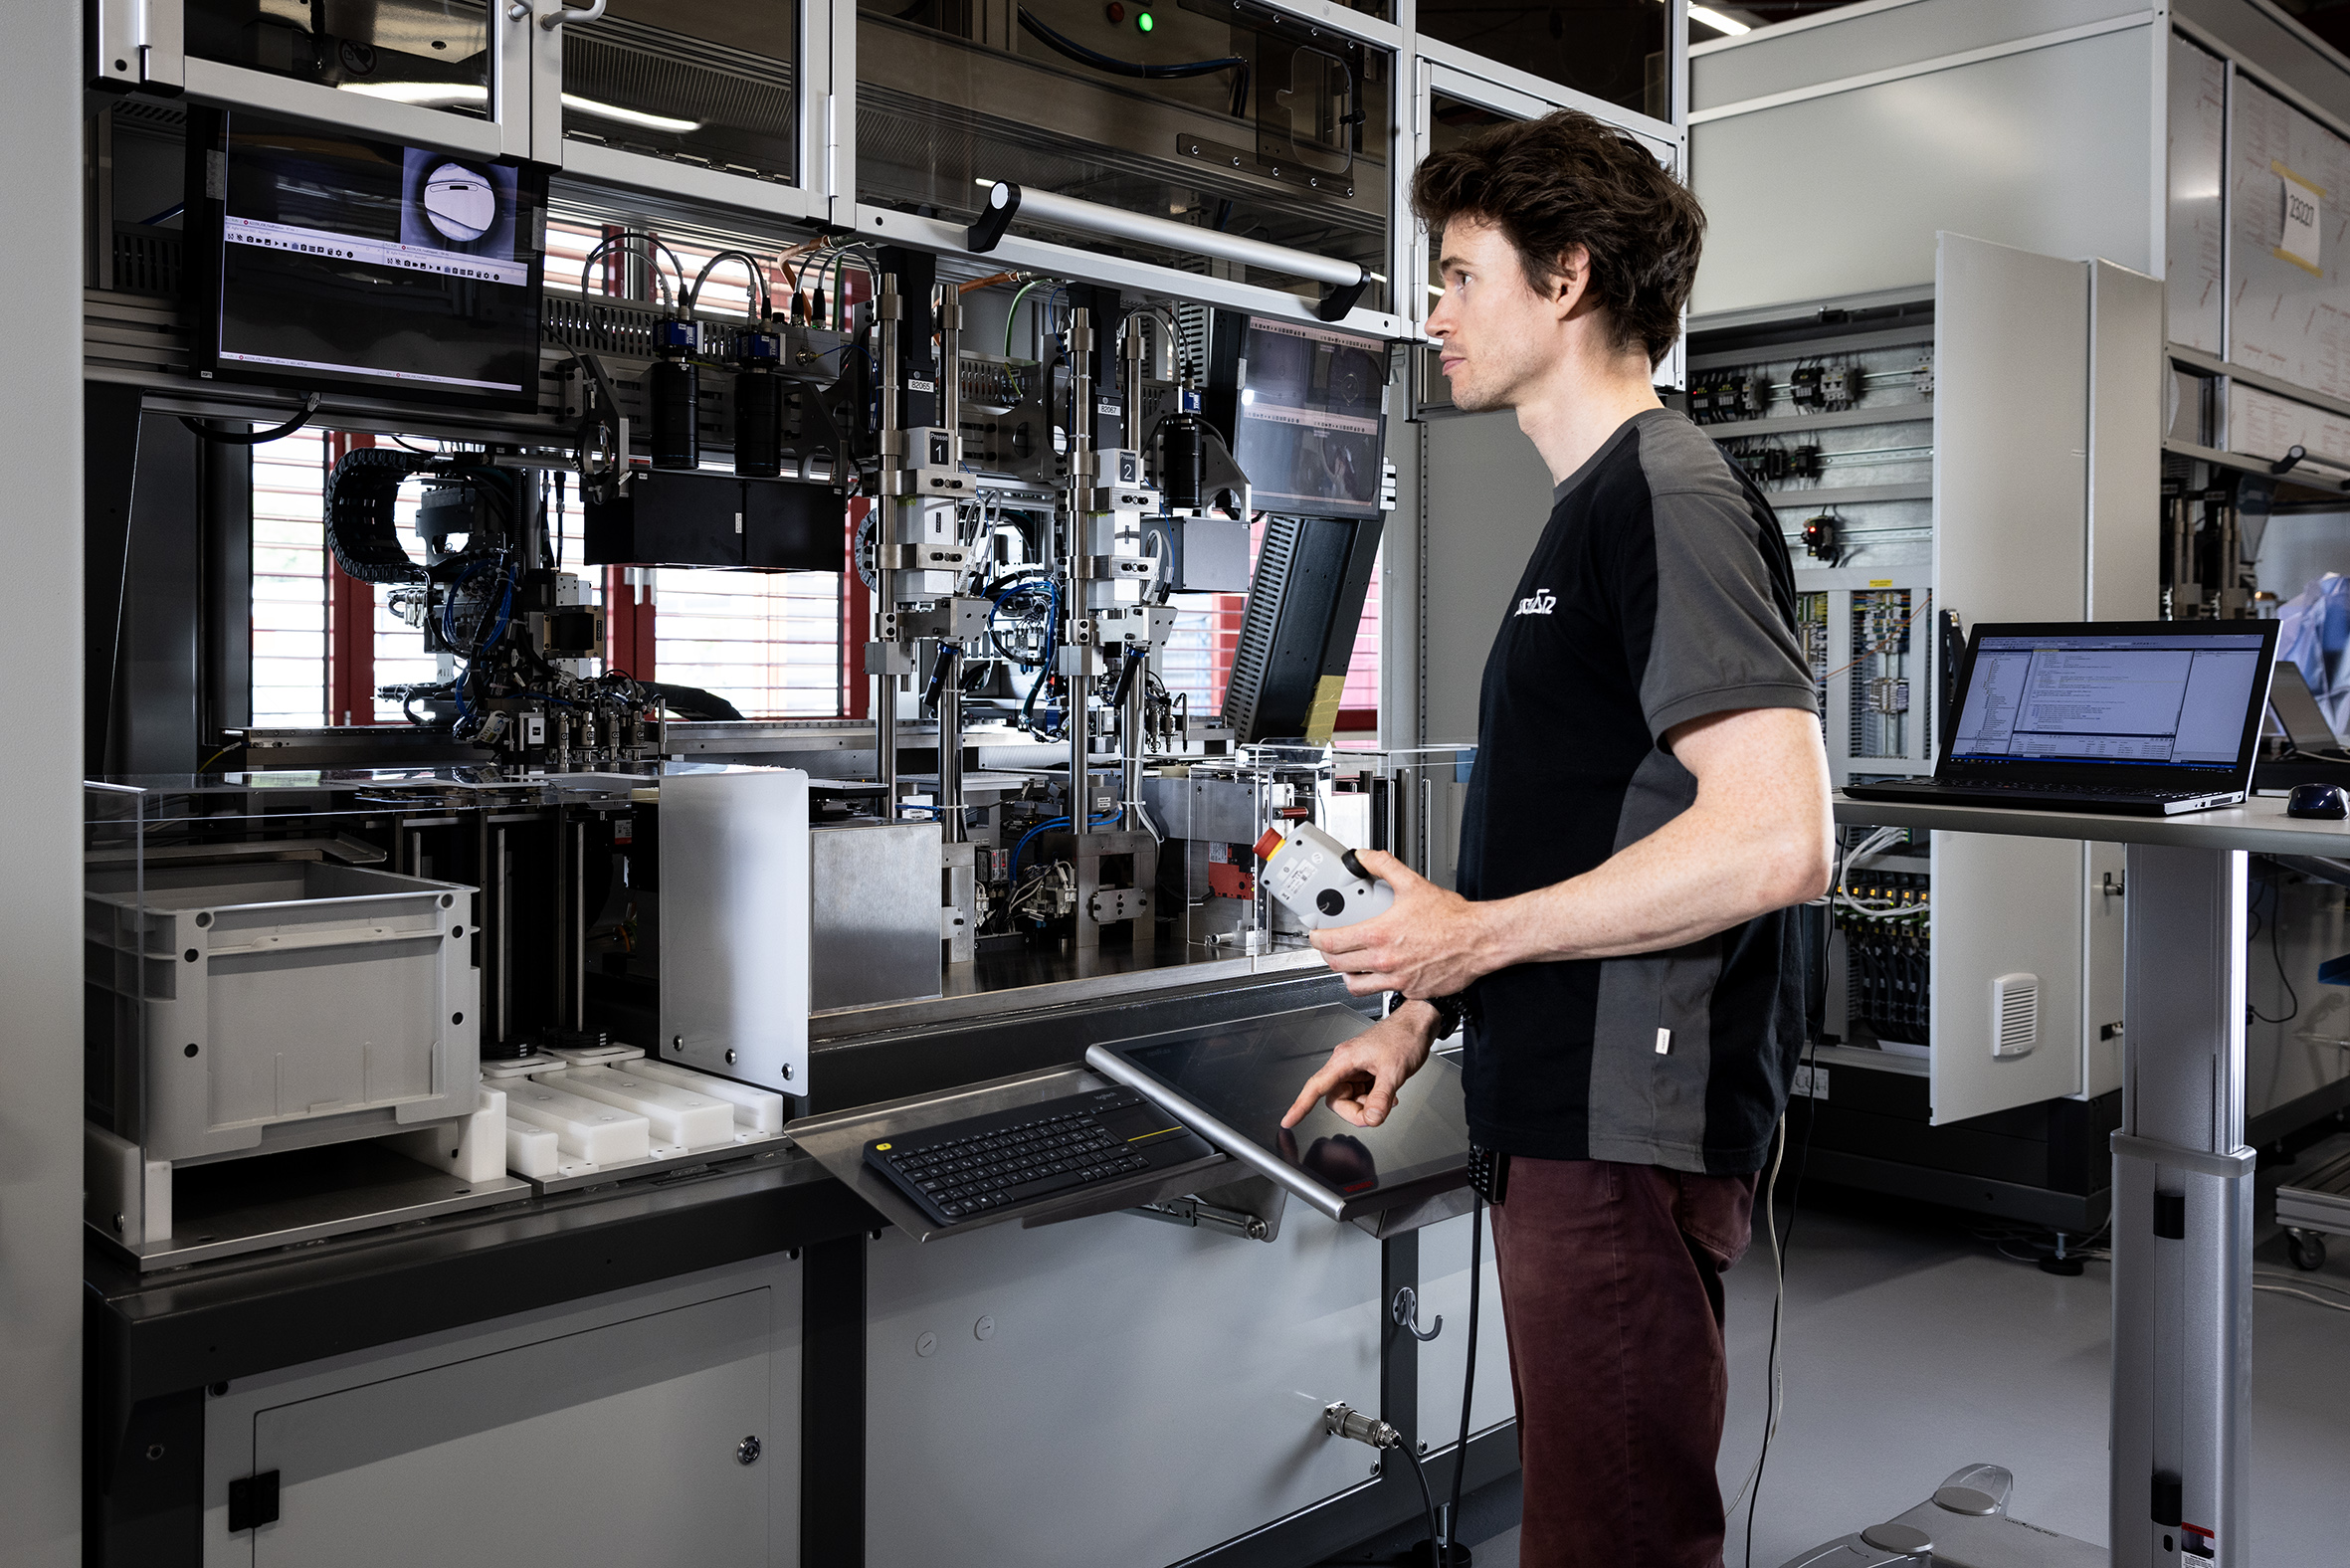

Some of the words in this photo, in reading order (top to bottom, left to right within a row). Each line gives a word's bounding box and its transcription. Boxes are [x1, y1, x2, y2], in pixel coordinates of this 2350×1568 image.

[911, 381, 931, 391] 82065
[1100, 405, 1117, 414] 82067
[930, 432, 948, 442] Presse
[935, 444, 942, 462] 1
[1120, 453, 1136, 462] Presse
[1123, 464, 1132, 480] 2
[1093, 1091, 1117, 1100] logitech
